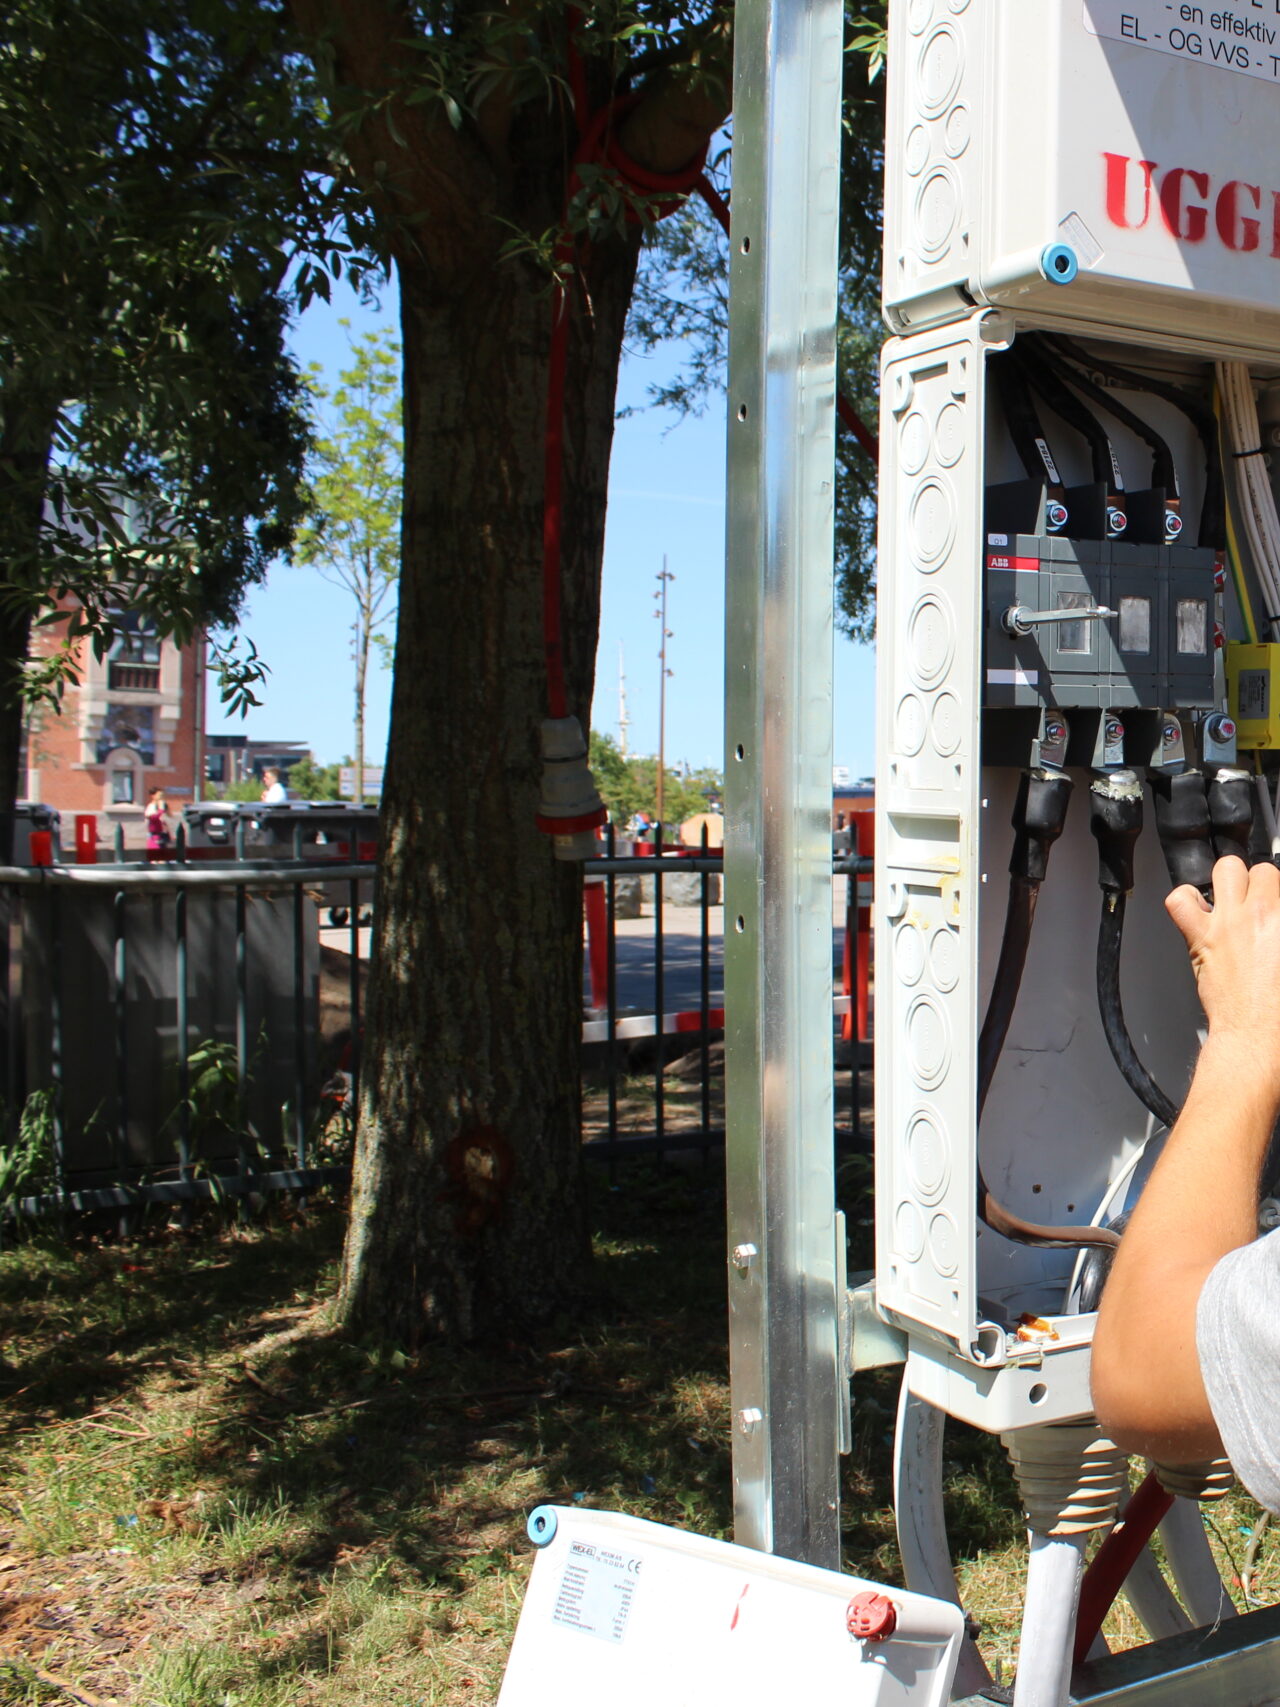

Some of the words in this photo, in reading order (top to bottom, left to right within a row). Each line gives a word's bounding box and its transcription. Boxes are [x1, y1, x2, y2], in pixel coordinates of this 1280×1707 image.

[1121, 14, 1148, 42] EL
[1168, 27, 1202, 56] OG
[1208, 38, 1250, 69] VVS
[1179, 4, 1204, 25] en
[1210, 11, 1276, 45] effektiv
[991, 557, 1009, 567] ABB
